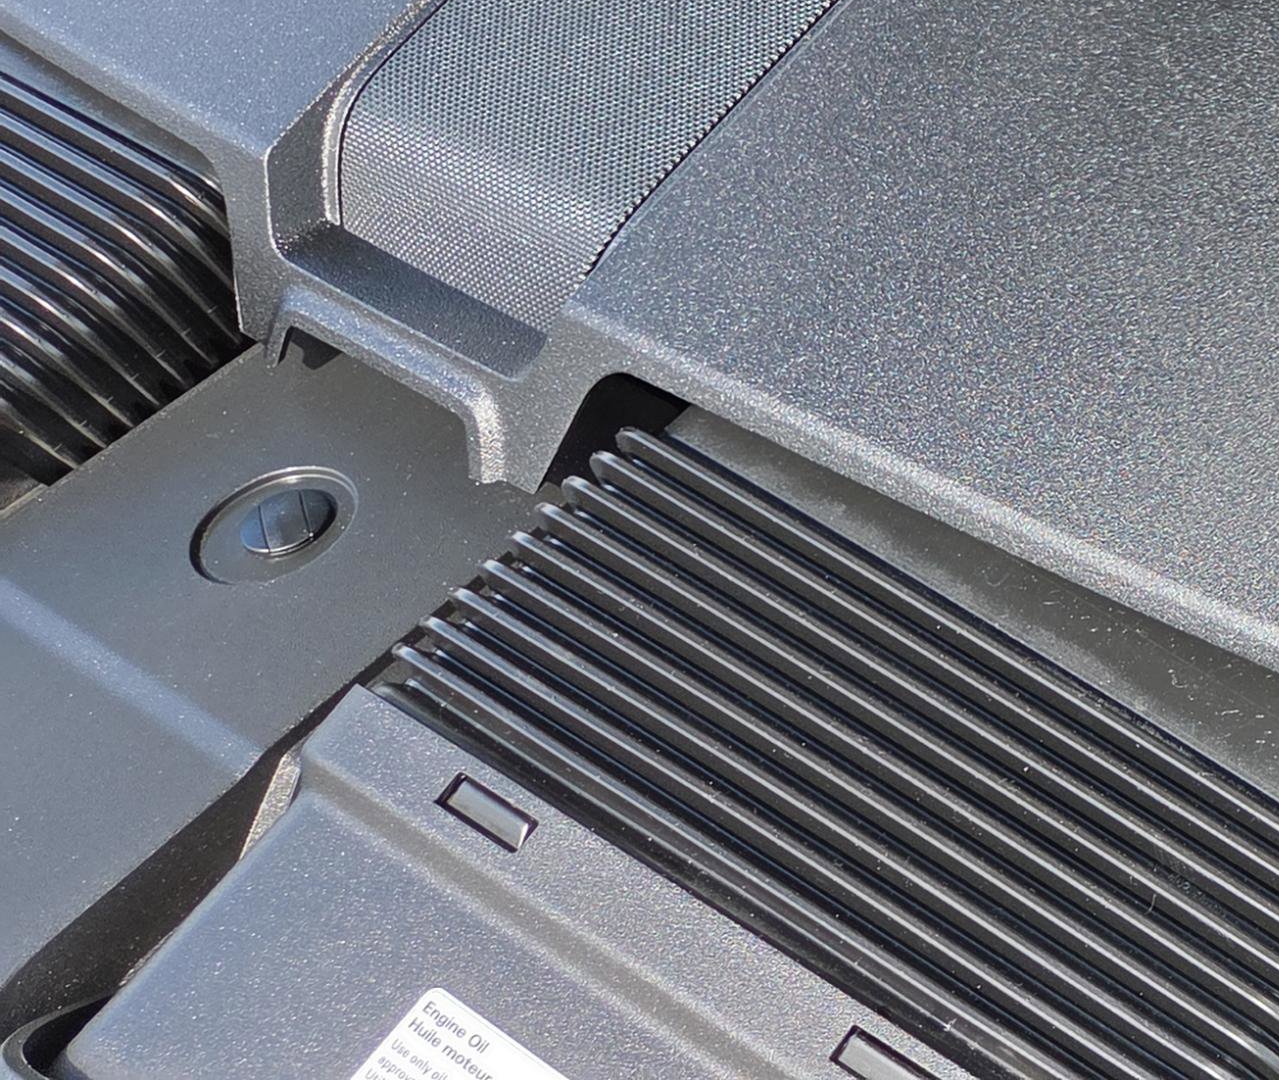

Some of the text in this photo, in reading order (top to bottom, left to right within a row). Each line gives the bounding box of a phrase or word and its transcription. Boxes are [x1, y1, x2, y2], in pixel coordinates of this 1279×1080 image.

[408, 1016, 494, 1080] Huile moteur
[422, 1000, 490, 1054] Engine Oil
[391, 1038, 410, 1058] Use
[409, 1055, 432, 1075] only
